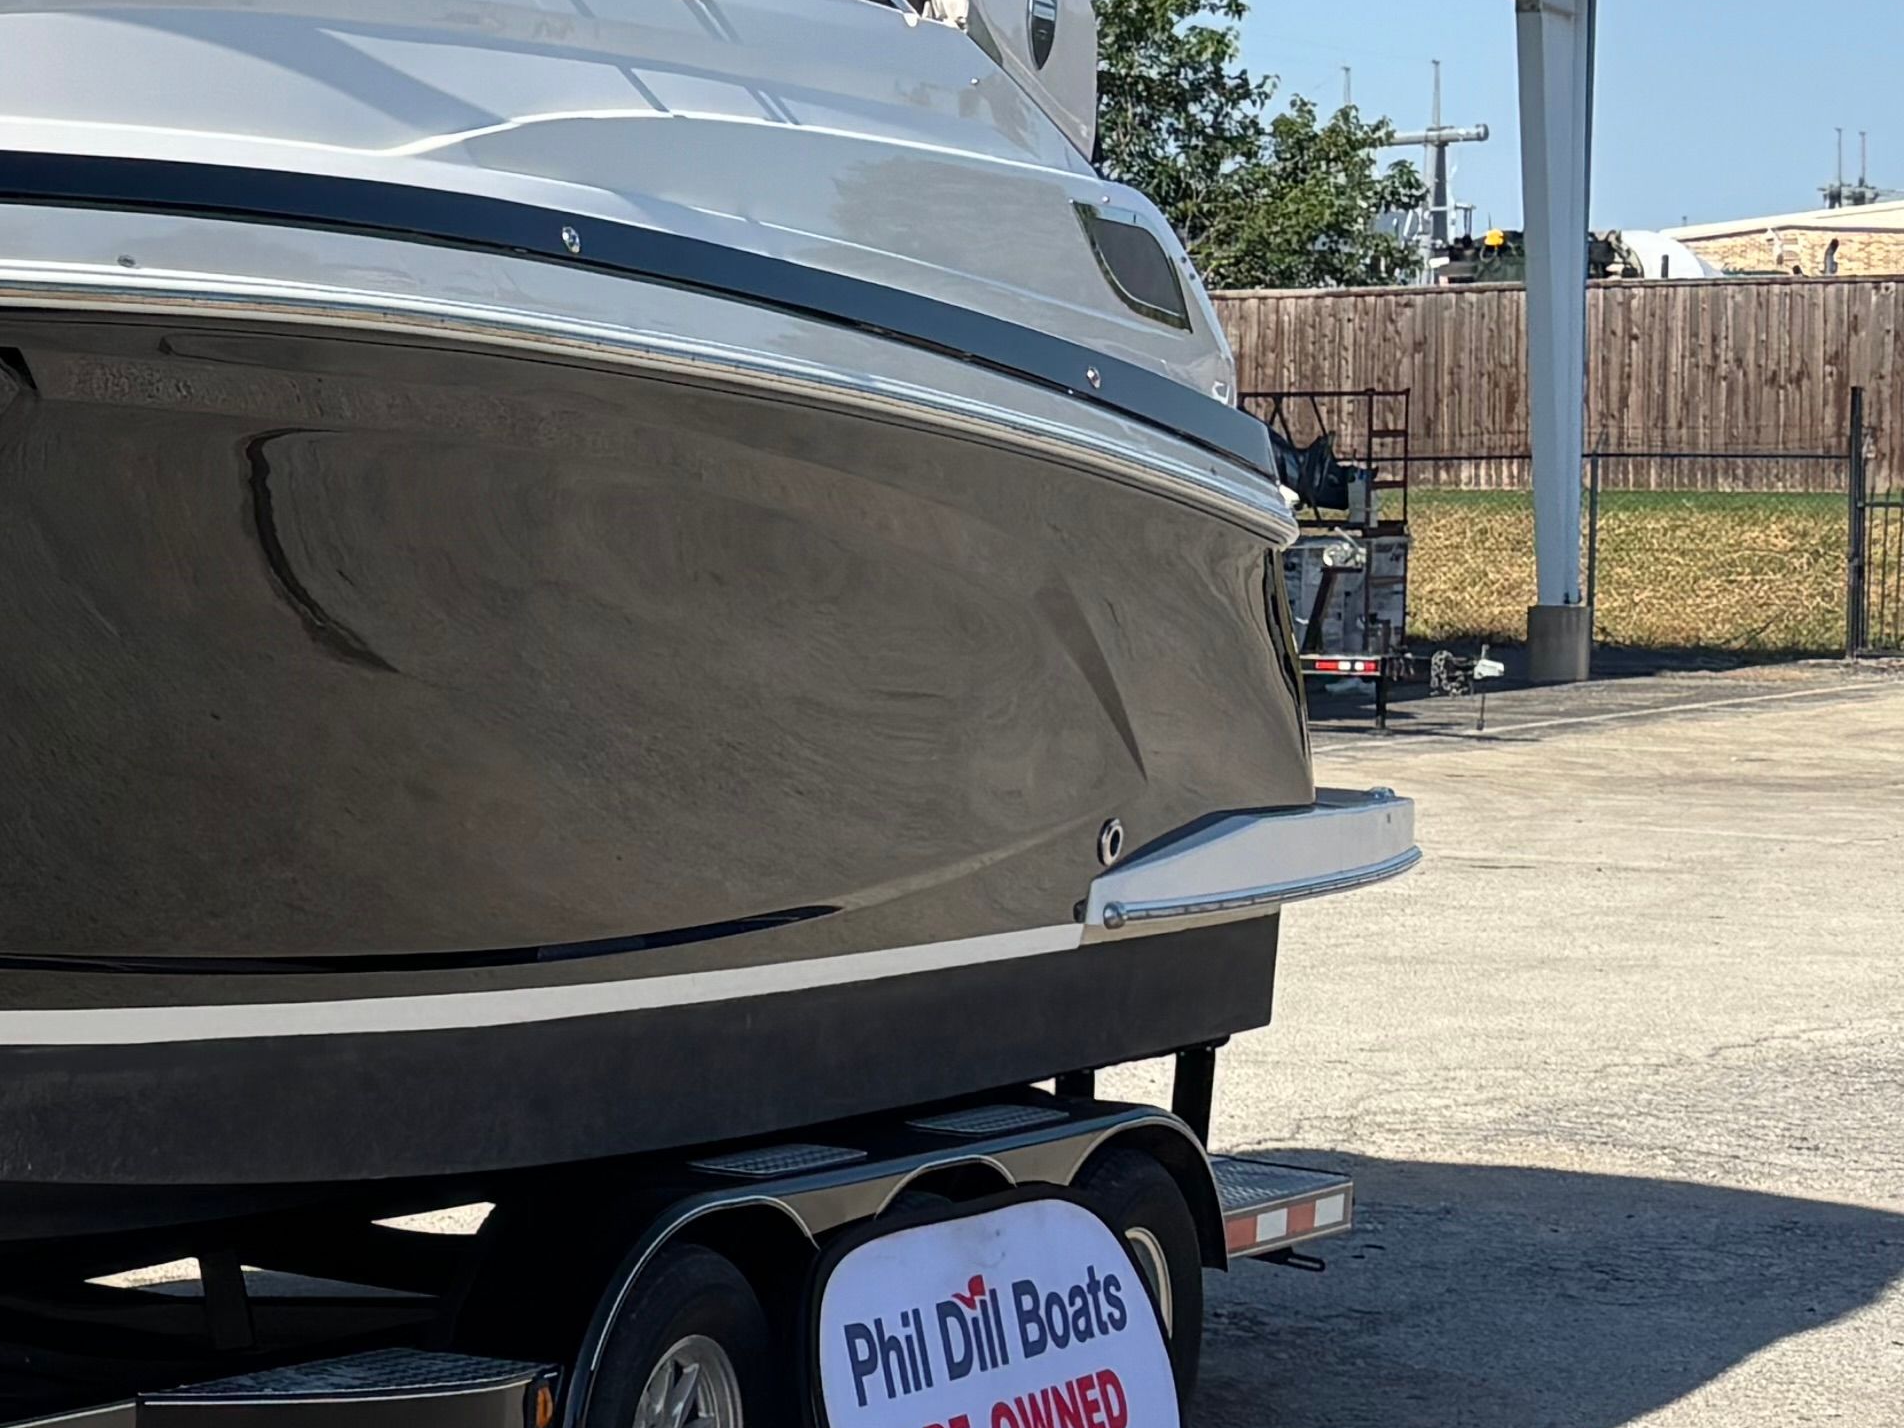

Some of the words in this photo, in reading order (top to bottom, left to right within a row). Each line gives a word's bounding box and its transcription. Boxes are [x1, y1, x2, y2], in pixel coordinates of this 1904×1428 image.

[843, 1306, 934, 1408] Phil
[936, 1283, 1010, 1381] Dill
[1011, 1264, 1128, 1359] Boats
